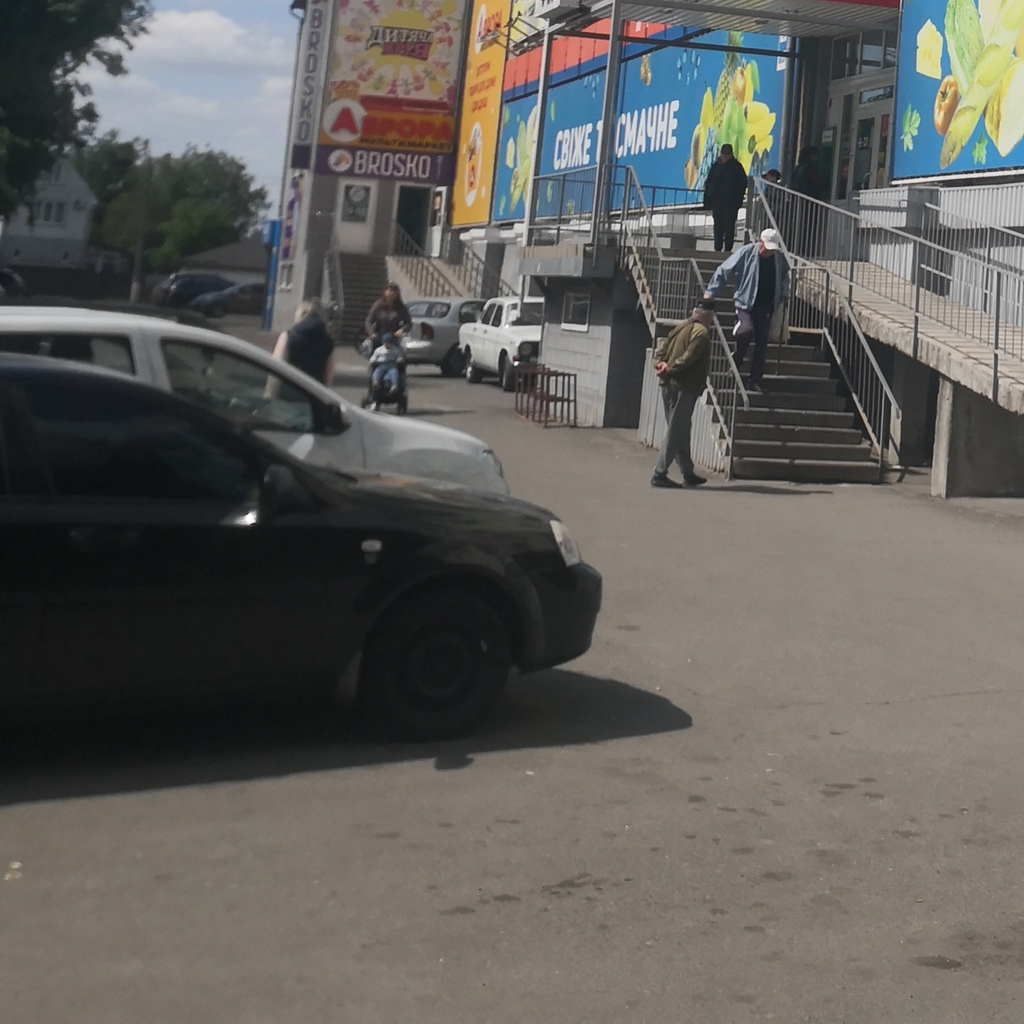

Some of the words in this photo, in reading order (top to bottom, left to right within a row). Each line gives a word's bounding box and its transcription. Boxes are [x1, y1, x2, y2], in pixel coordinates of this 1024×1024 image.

[298, 8, 323, 142] BROSKO
[353, 149, 432, 179] BROSKO
[553, 123, 593, 171] СВІЖЕ
[615, 100, 680, 159] СМАЧНЕ
